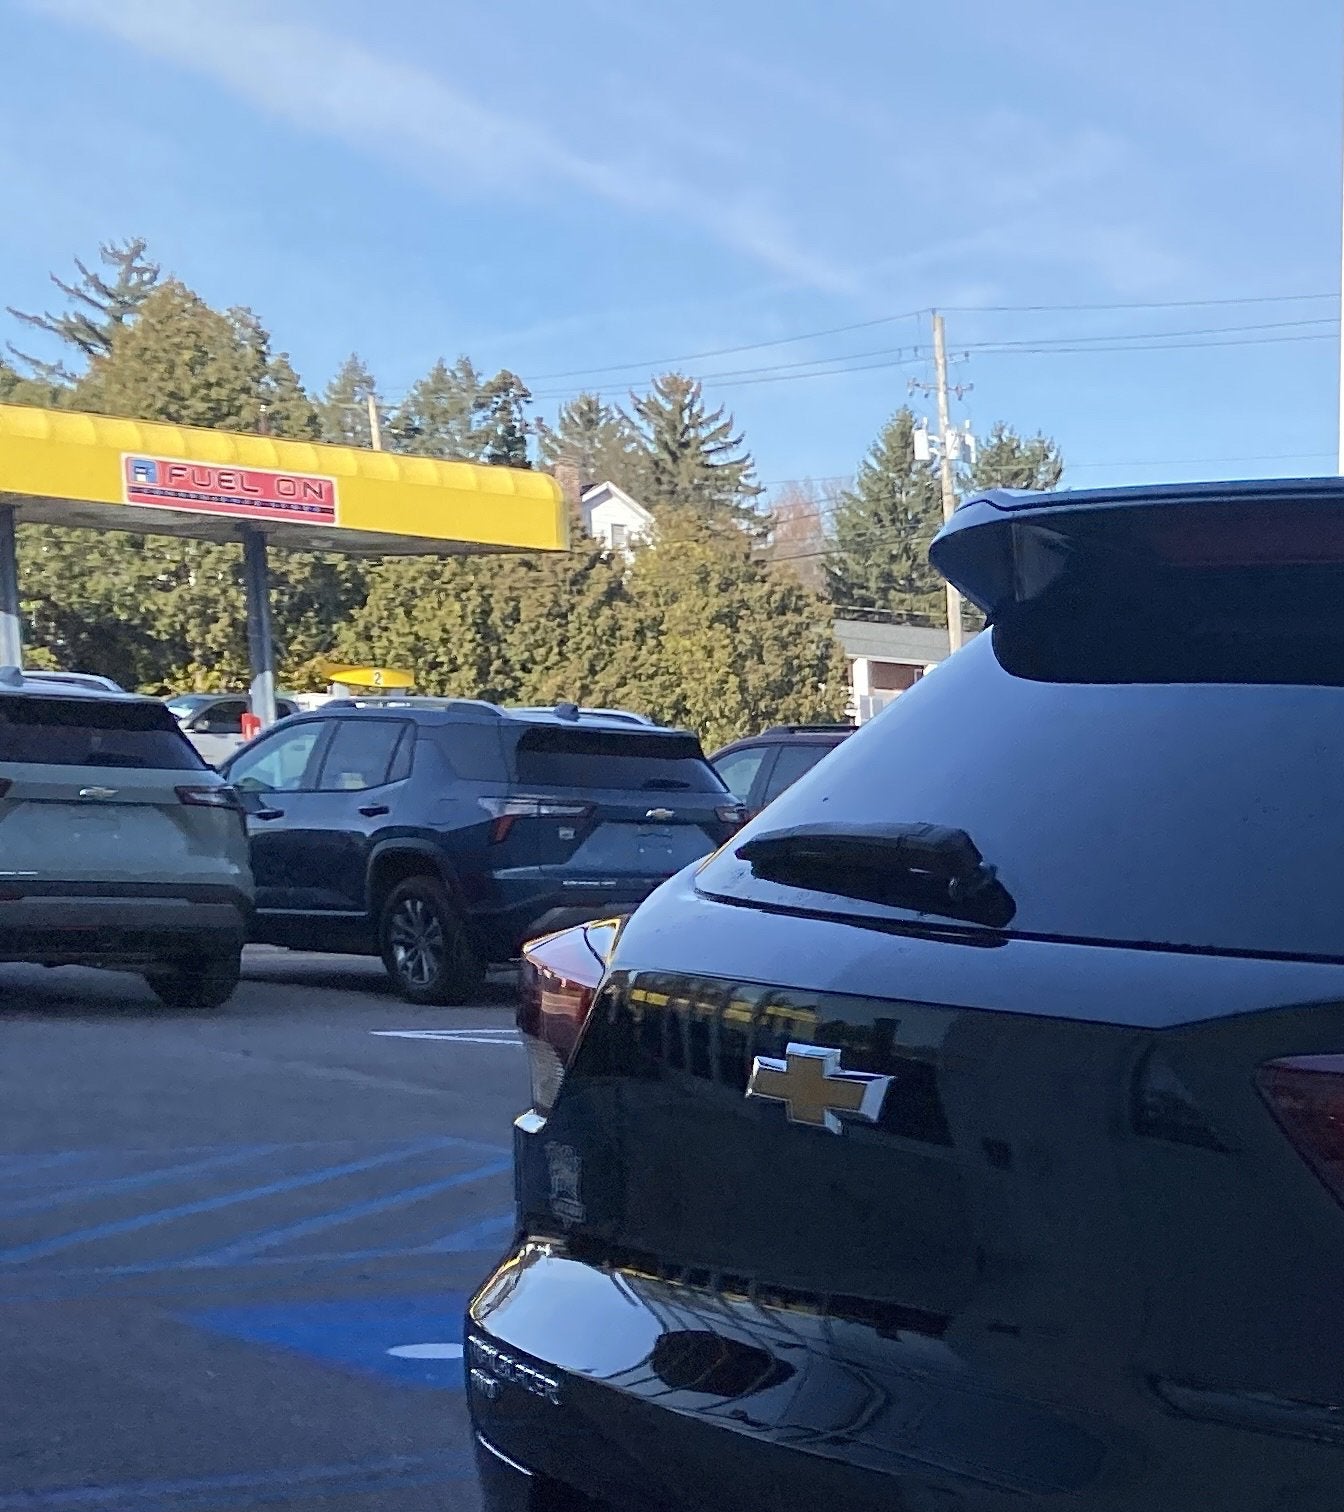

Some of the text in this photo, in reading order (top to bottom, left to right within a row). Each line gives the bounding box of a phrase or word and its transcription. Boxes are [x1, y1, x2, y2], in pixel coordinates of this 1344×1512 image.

[168, 466, 259, 493] FUEL
[276, 478, 324, 500] ON
[374, 671, 382, 685] 2
